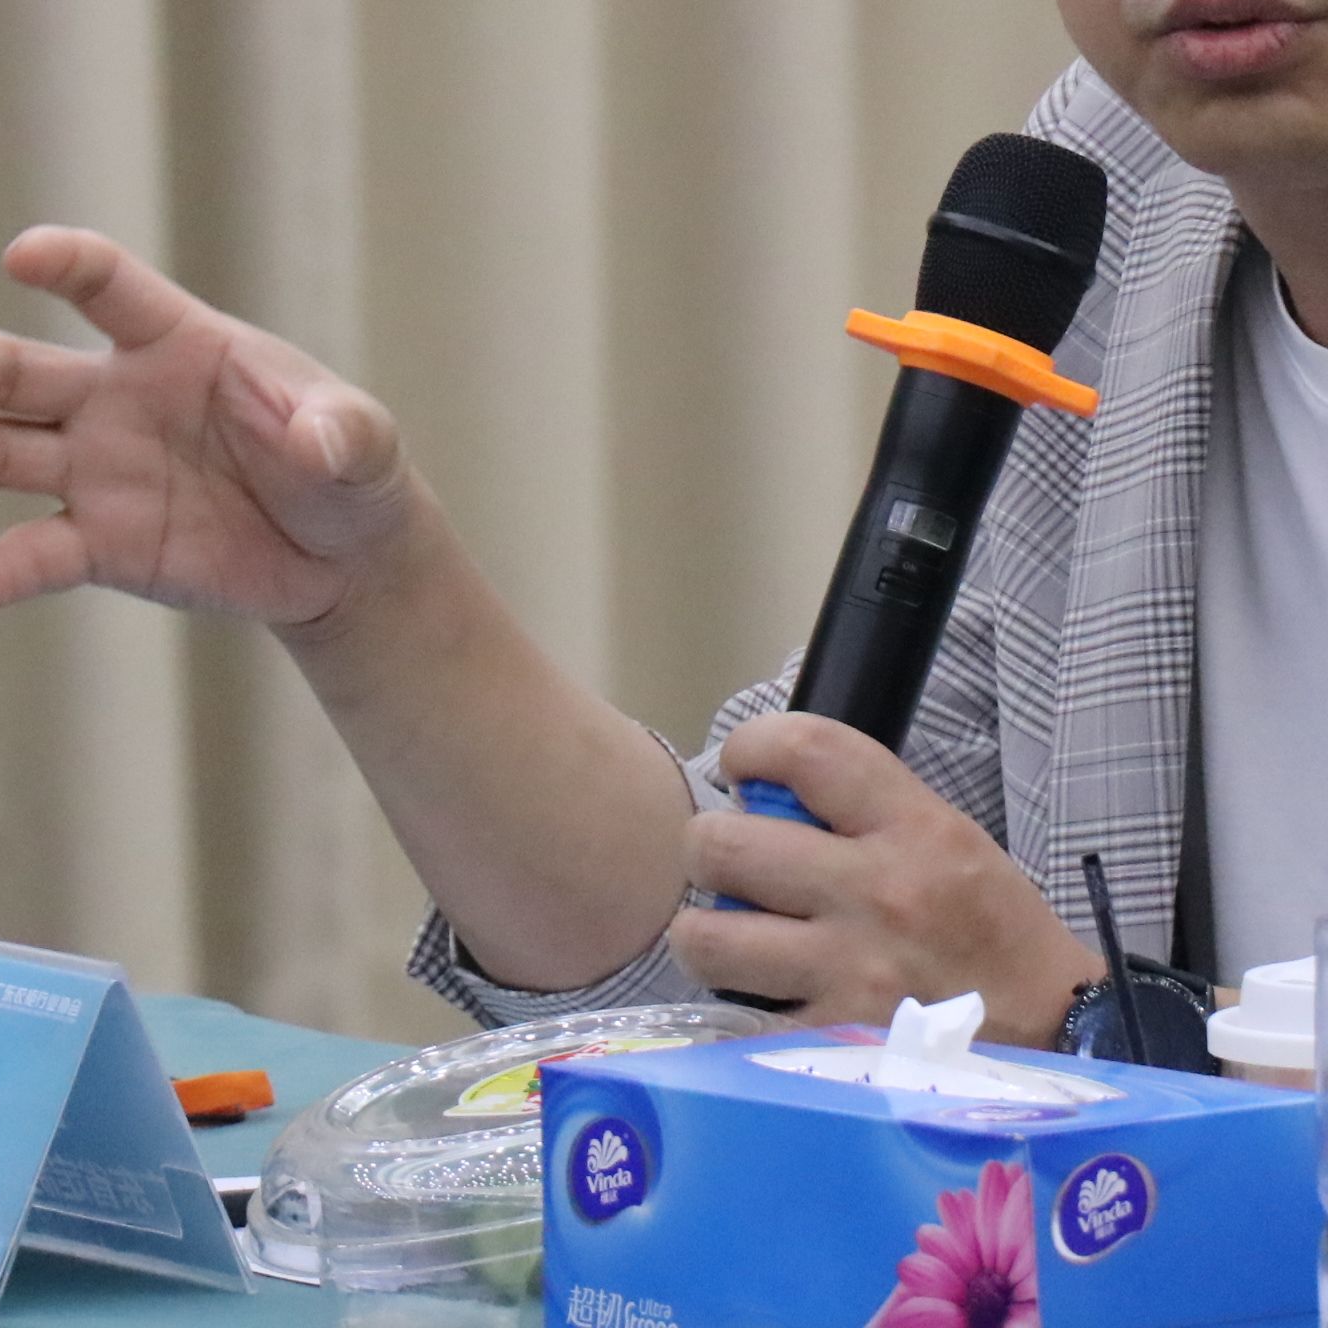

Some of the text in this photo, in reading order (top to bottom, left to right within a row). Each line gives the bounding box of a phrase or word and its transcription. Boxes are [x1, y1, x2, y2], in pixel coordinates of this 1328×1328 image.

[586, 1167, 633, 1194] Vinda
[1077, 1200, 1133, 1233] Vinda
[638, 1298, 673, 1320] Ultra
